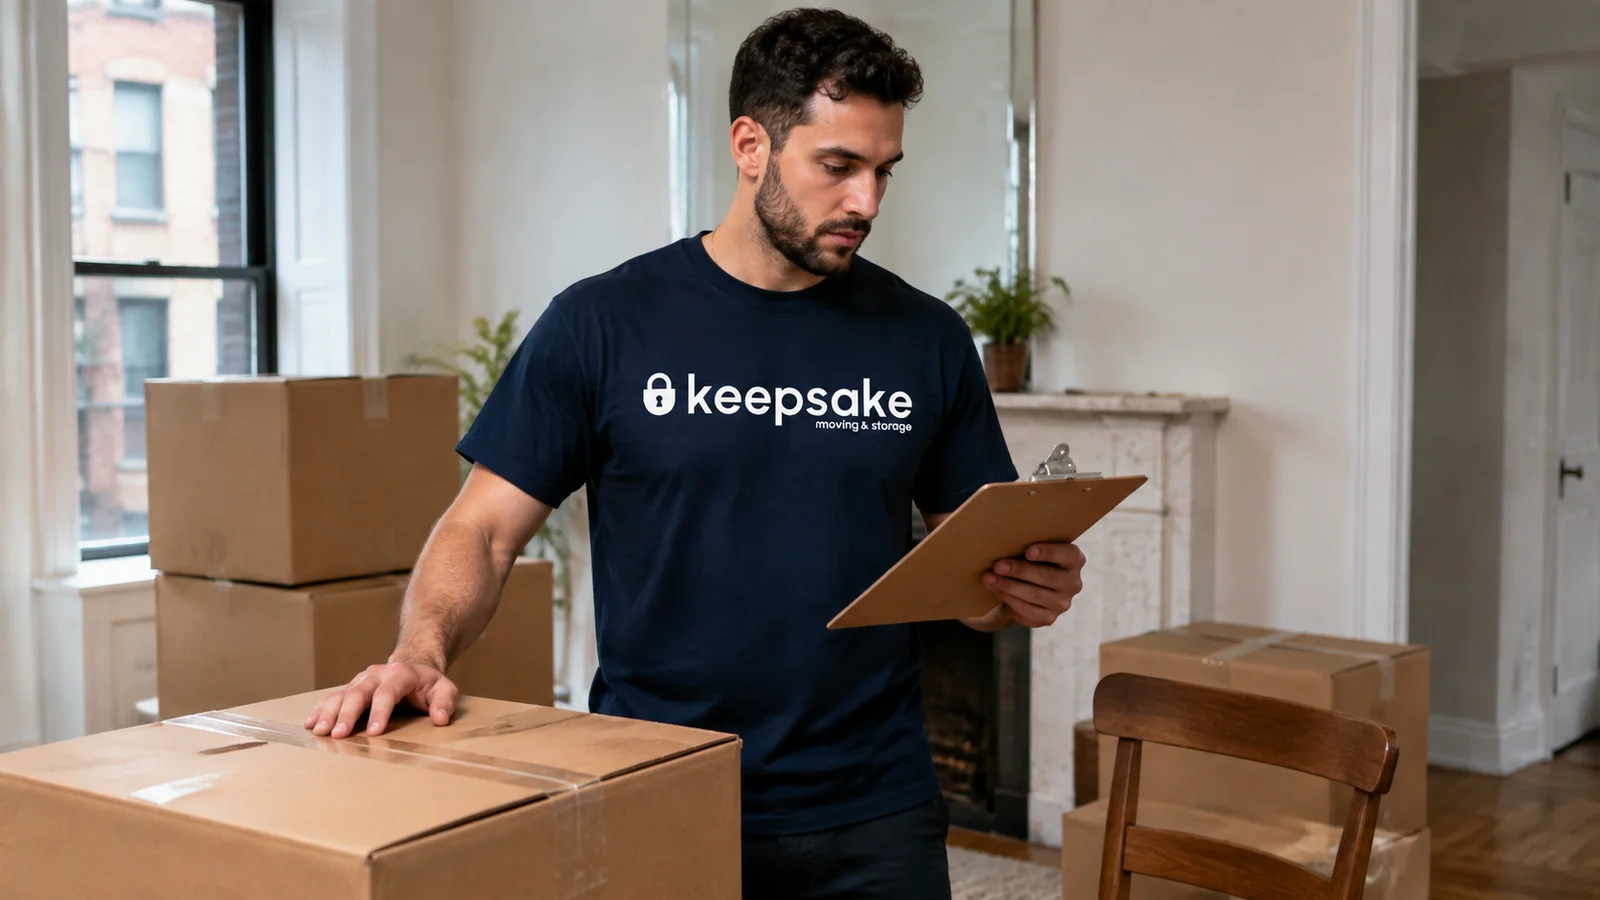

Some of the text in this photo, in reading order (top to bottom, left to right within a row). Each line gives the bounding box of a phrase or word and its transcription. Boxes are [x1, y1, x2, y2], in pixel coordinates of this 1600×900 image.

[687, 372, 913, 427] keepsake
[815, 420, 912, 434] moving & storage
